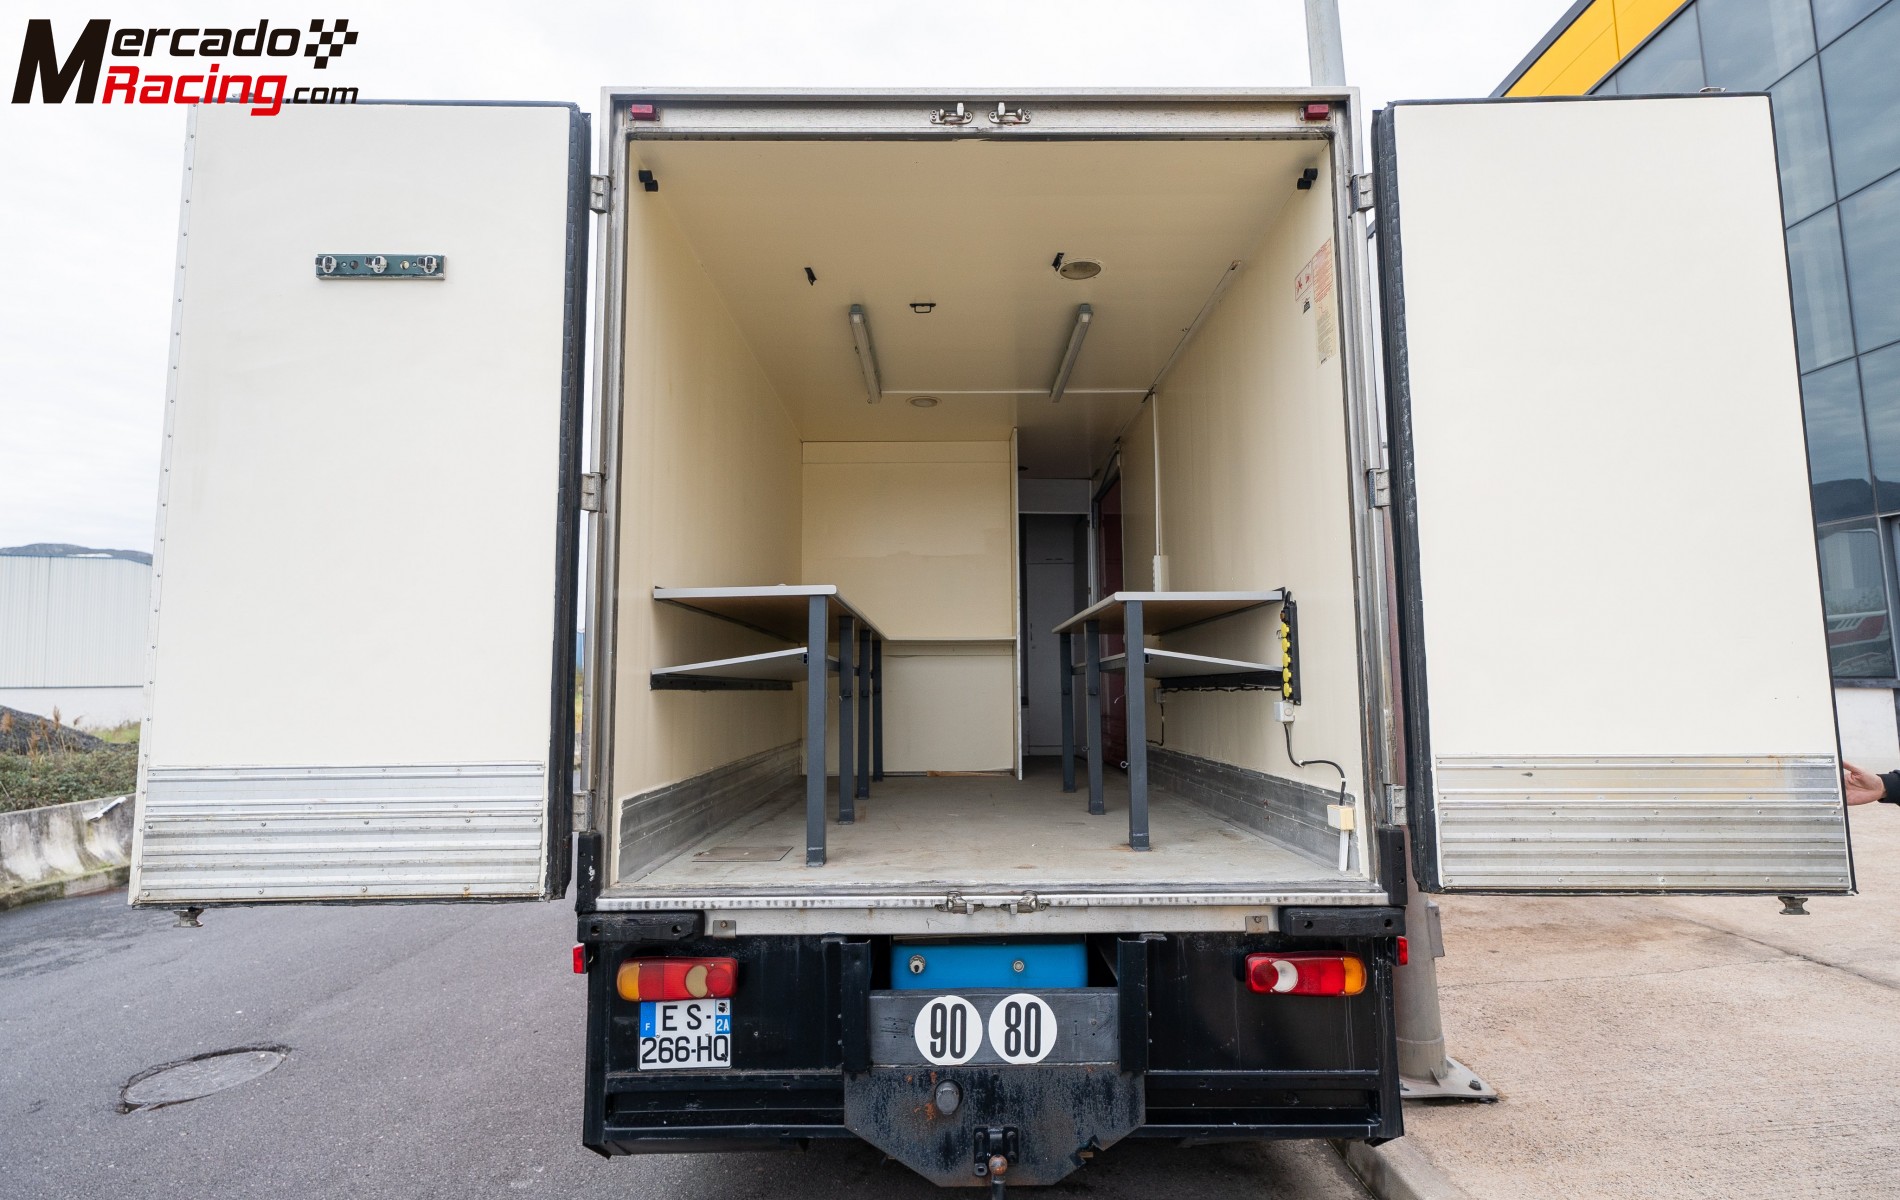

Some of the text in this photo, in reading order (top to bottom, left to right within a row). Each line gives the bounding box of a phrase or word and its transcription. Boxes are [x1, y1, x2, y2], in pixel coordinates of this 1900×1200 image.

[645, 1022, 651, 1031] F
[716, 1018, 729, 1031] 2A
[930, 1002, 967, 1059] 90
[1004, 1001, 1041, 1057] 80
[641, 1035, 729, 1063] 266-HQ
